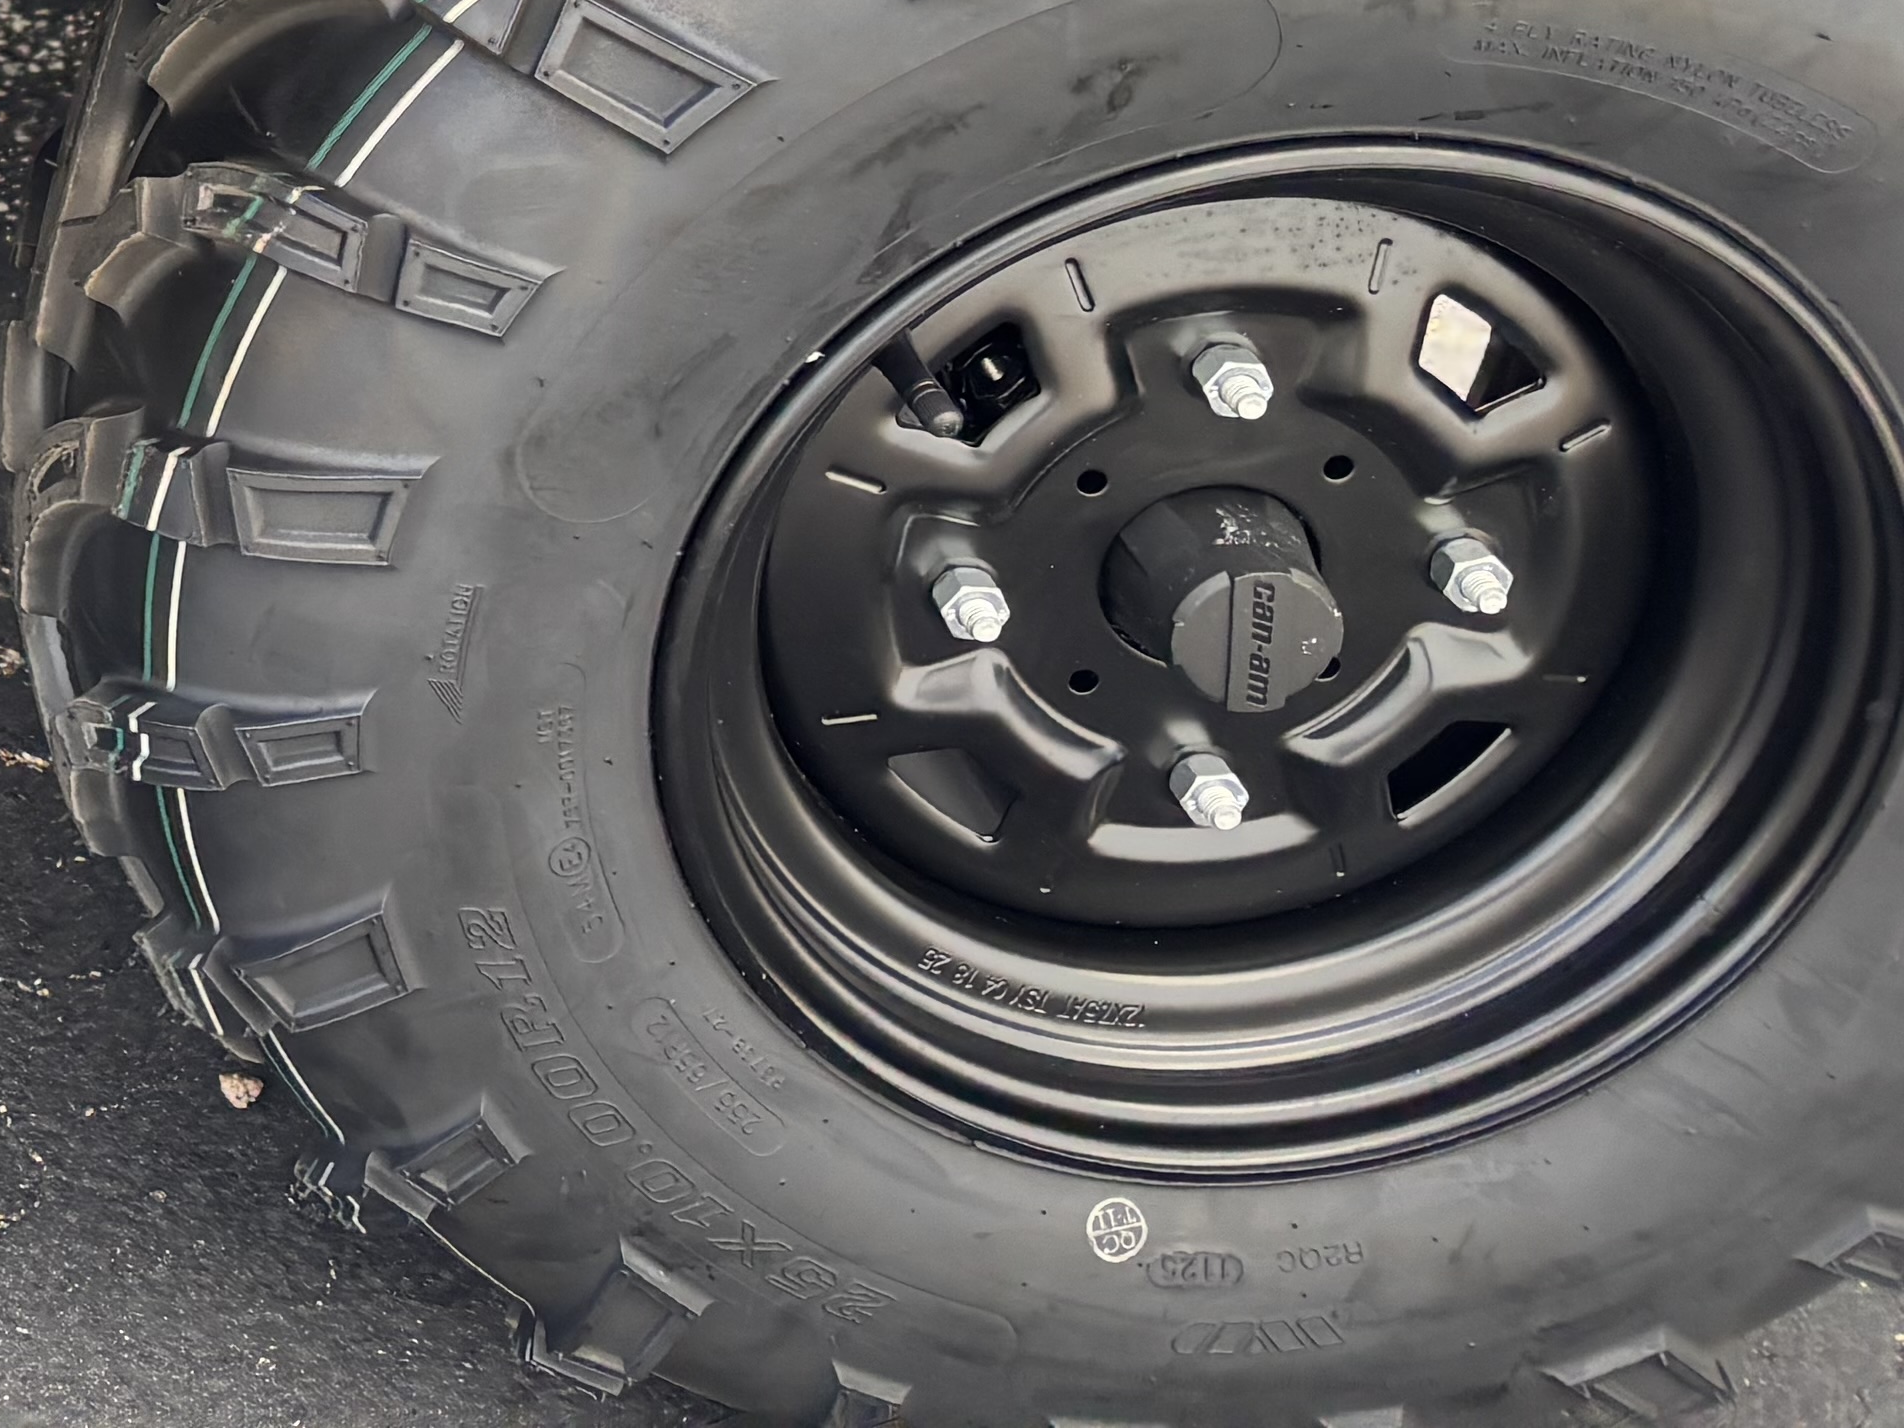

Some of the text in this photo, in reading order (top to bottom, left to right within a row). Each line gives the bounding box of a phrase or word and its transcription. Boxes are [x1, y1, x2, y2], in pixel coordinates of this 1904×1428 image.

[1571, 31, 1657, 64] RATING
[437, 582, 474, 674] ROTATION
[1245, 579, 1276, 709] can-am
[918, 949, 952, 973] 25
